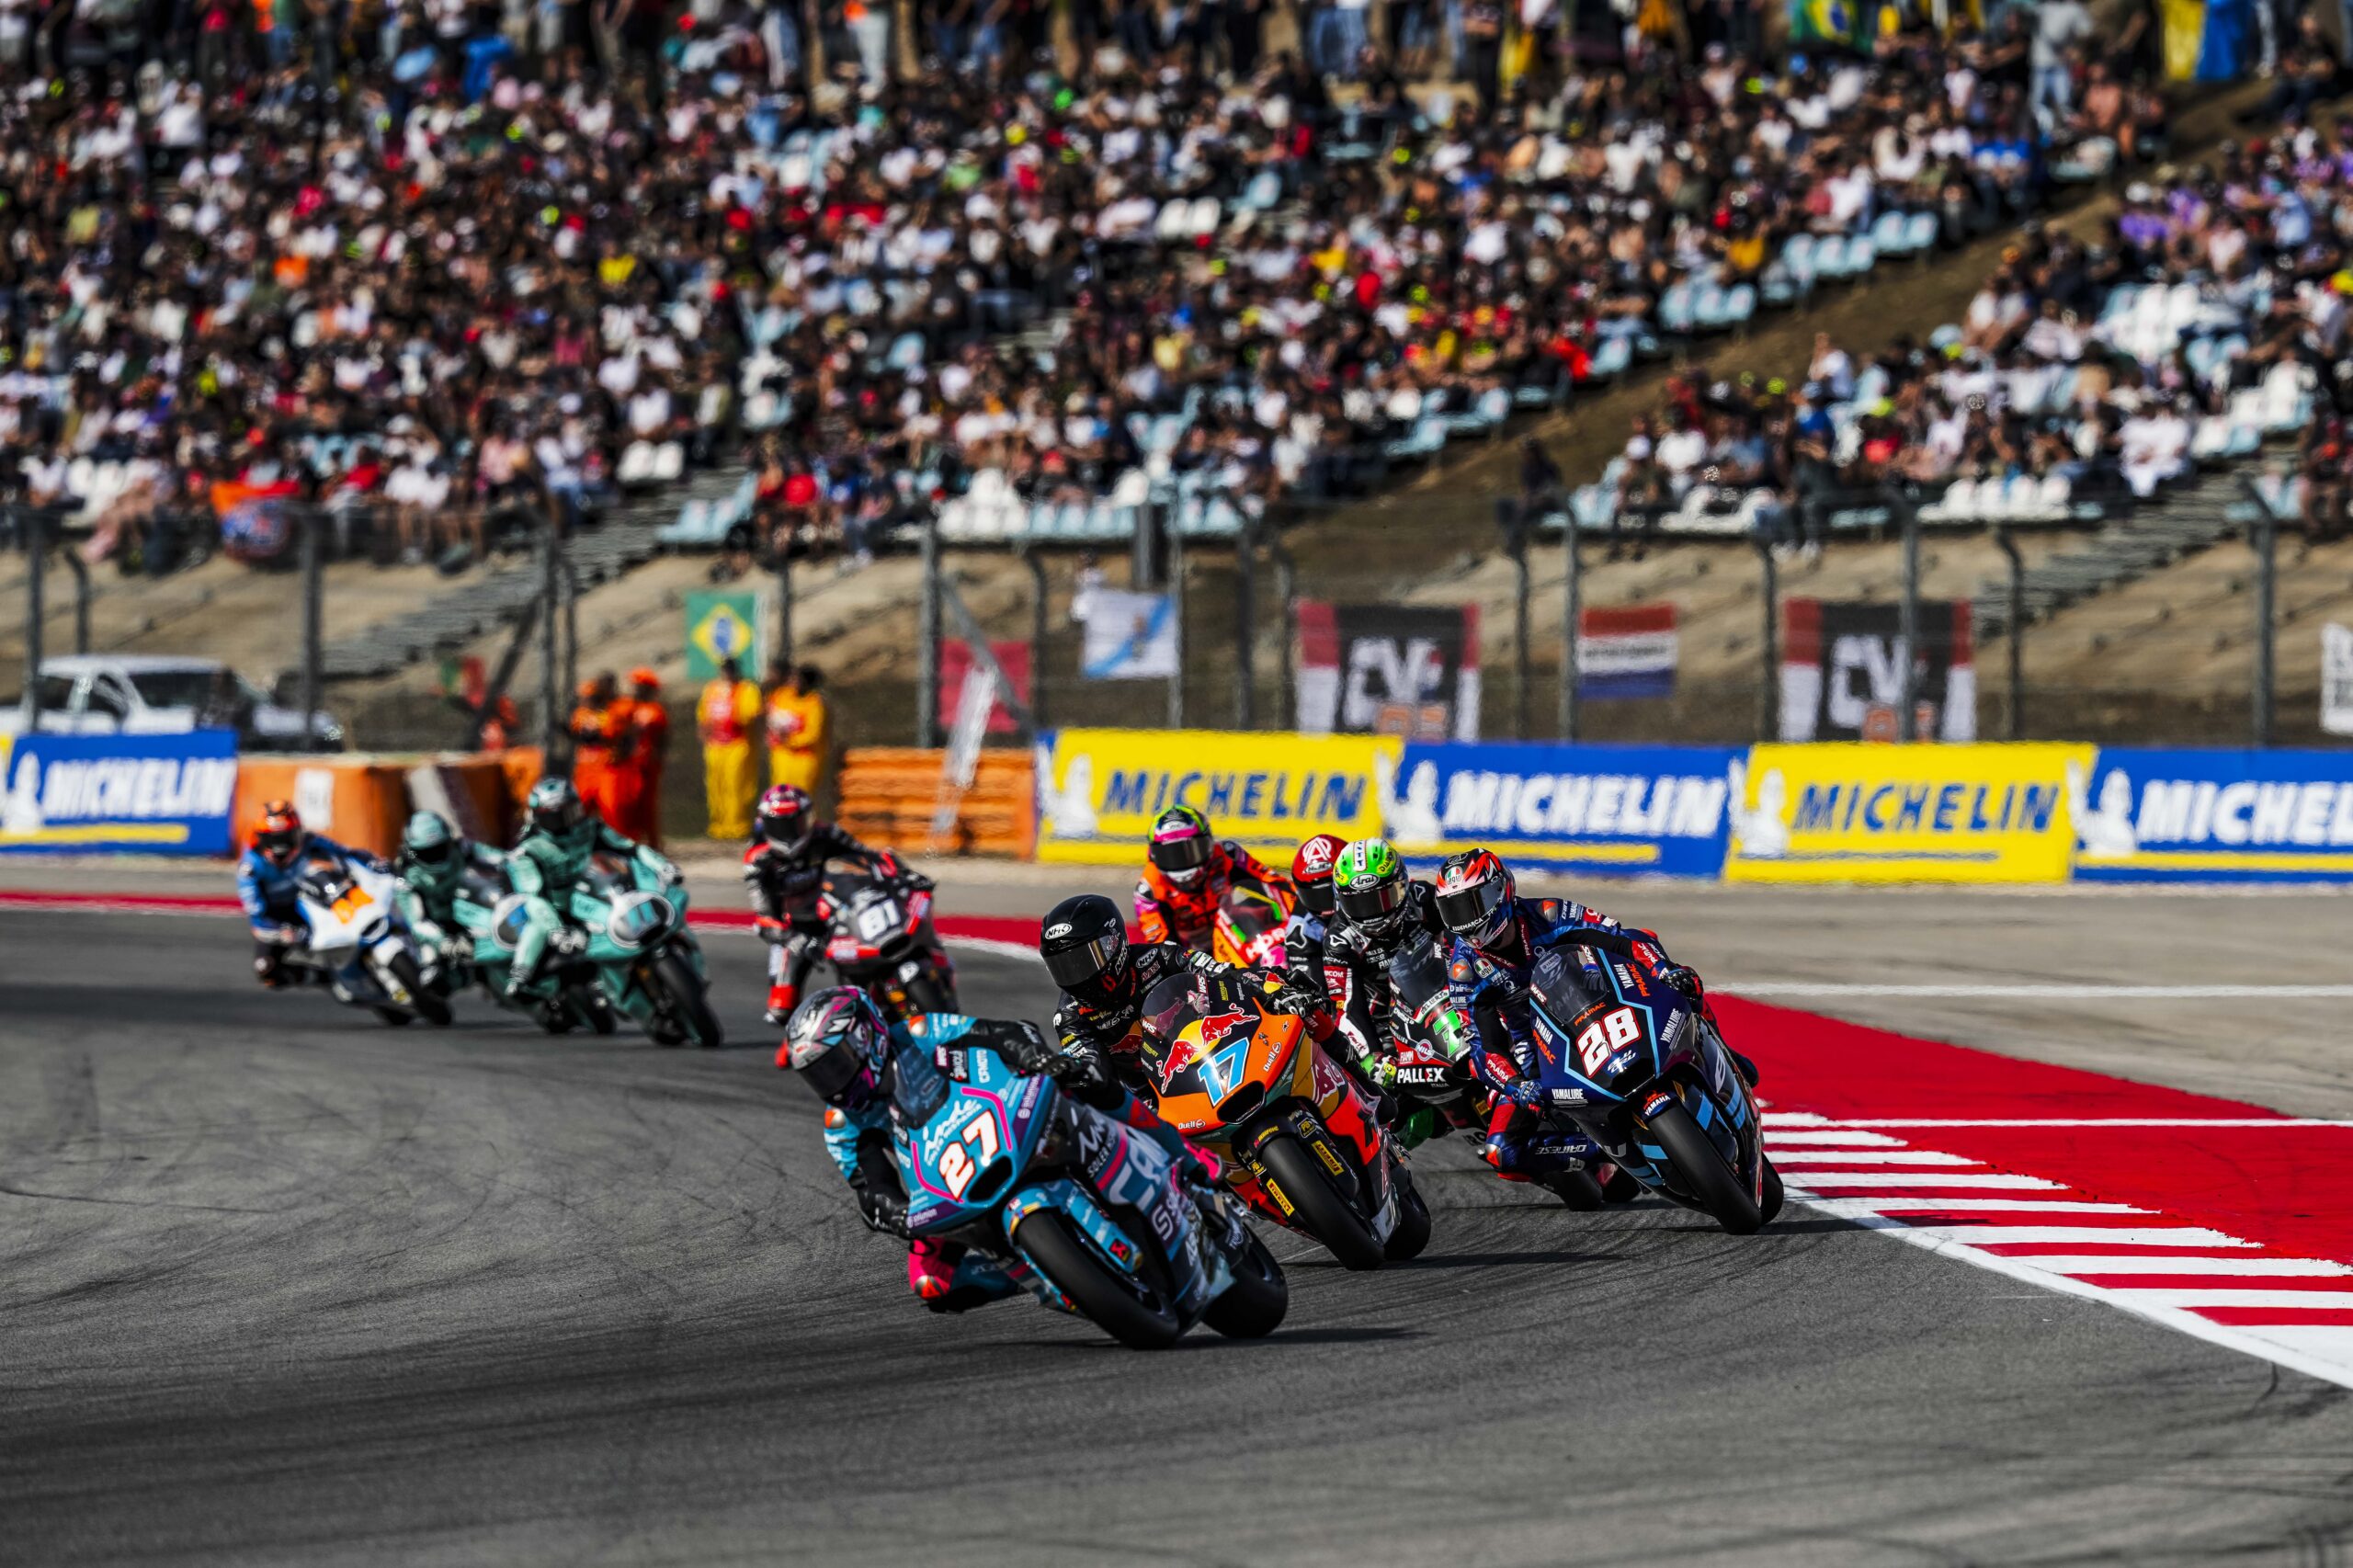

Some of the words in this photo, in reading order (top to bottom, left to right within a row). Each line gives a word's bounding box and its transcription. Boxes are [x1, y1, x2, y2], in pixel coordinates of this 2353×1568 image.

[42, 757, 237, 818] MICHELIN
[1102, 768, 1368, 823] MICHELIN
[1442, 770, 1726, 837] MICHELIN
[1793, 783, 2061, 833] MICHELIN
[1353, 874, 1376, 887] Arai
[858, 898, 901, 941] 81
[1434, 942, 1442, 959] WRS
[1582, 945, 1597, 965] WRS
[1198, 975, 1208, 994] WRS
[1614, 963, 1634, 990] YAMAHA
[1626, 962, 1651, 997] PRAMAC
[1530, 984, 1546, 1004] WRS
[1142, 1019, 1157, 1034] WRS
[1574, 1002, 1607, 1026] PRAMAC
[1660, 1008, 1682, 1043] YAMALUBE
[1433, 1008, 1462, 1058] 7
[1535, 1016, 1553, 1045] YAMAHA
[1575, 1006, 1642, 1079] 28
[1400, 1051, 1414, 1063] FIAMM
[1416, 1042, 1435, 1056] NILS
[1532, 1028, 1556, 1064] PRAMAC
[1197, 1037, 1250, 1108] 17
[1397, 1067, 1446, 1084] PALLEX
[1486, 1058, 1509, 1082] PRAMA
[1552, 1088, 1585, 1099] YAMALUBE
[1644, 1095, 1671, 1116] YAMAHA
[938, 1109, 1000, 1202] 27
[1535, 1144, 1587, 1156] DAINESE
